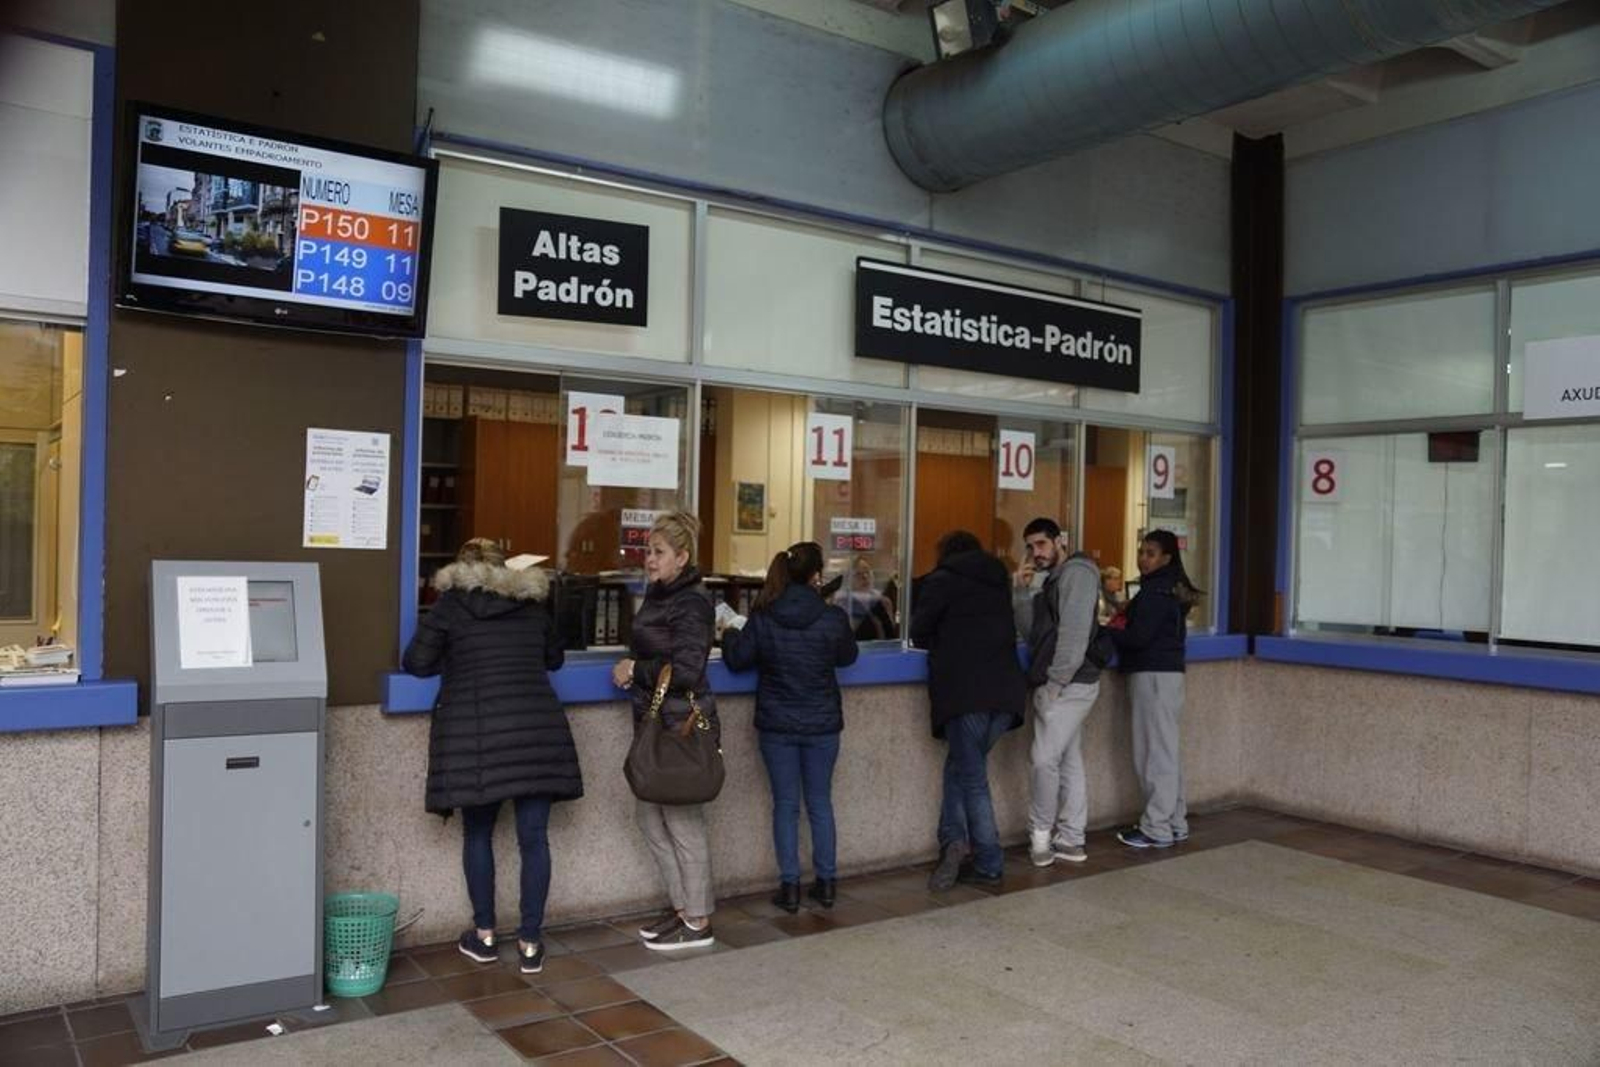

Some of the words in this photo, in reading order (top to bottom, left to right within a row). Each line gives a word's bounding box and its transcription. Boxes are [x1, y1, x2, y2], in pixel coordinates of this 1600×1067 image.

[178, 136, 232, 152] VOLANTES
[302, 176, 350, 205] NUMERO
[388, 190, 419, 215] MESA
[300, 208, 370, 240] P150
[387, 222, 414, 247] 11
[298, 240, 368, 269] P149
[385, 253, 412, 275] 11
[532, 230, 620, 266] Altas
[296, 269, 365, 297] P148
[381, 281, 412, 303] 09
[513, 270, 634, 309] Padrón
[811, 425, 848, 468] 11
[1001, 441, 1033, 479] 10
[1152, 453, 1169, 490] 9
[1312, 459, 1336, 495] 8
[623, 510, 653, 522] MESA
